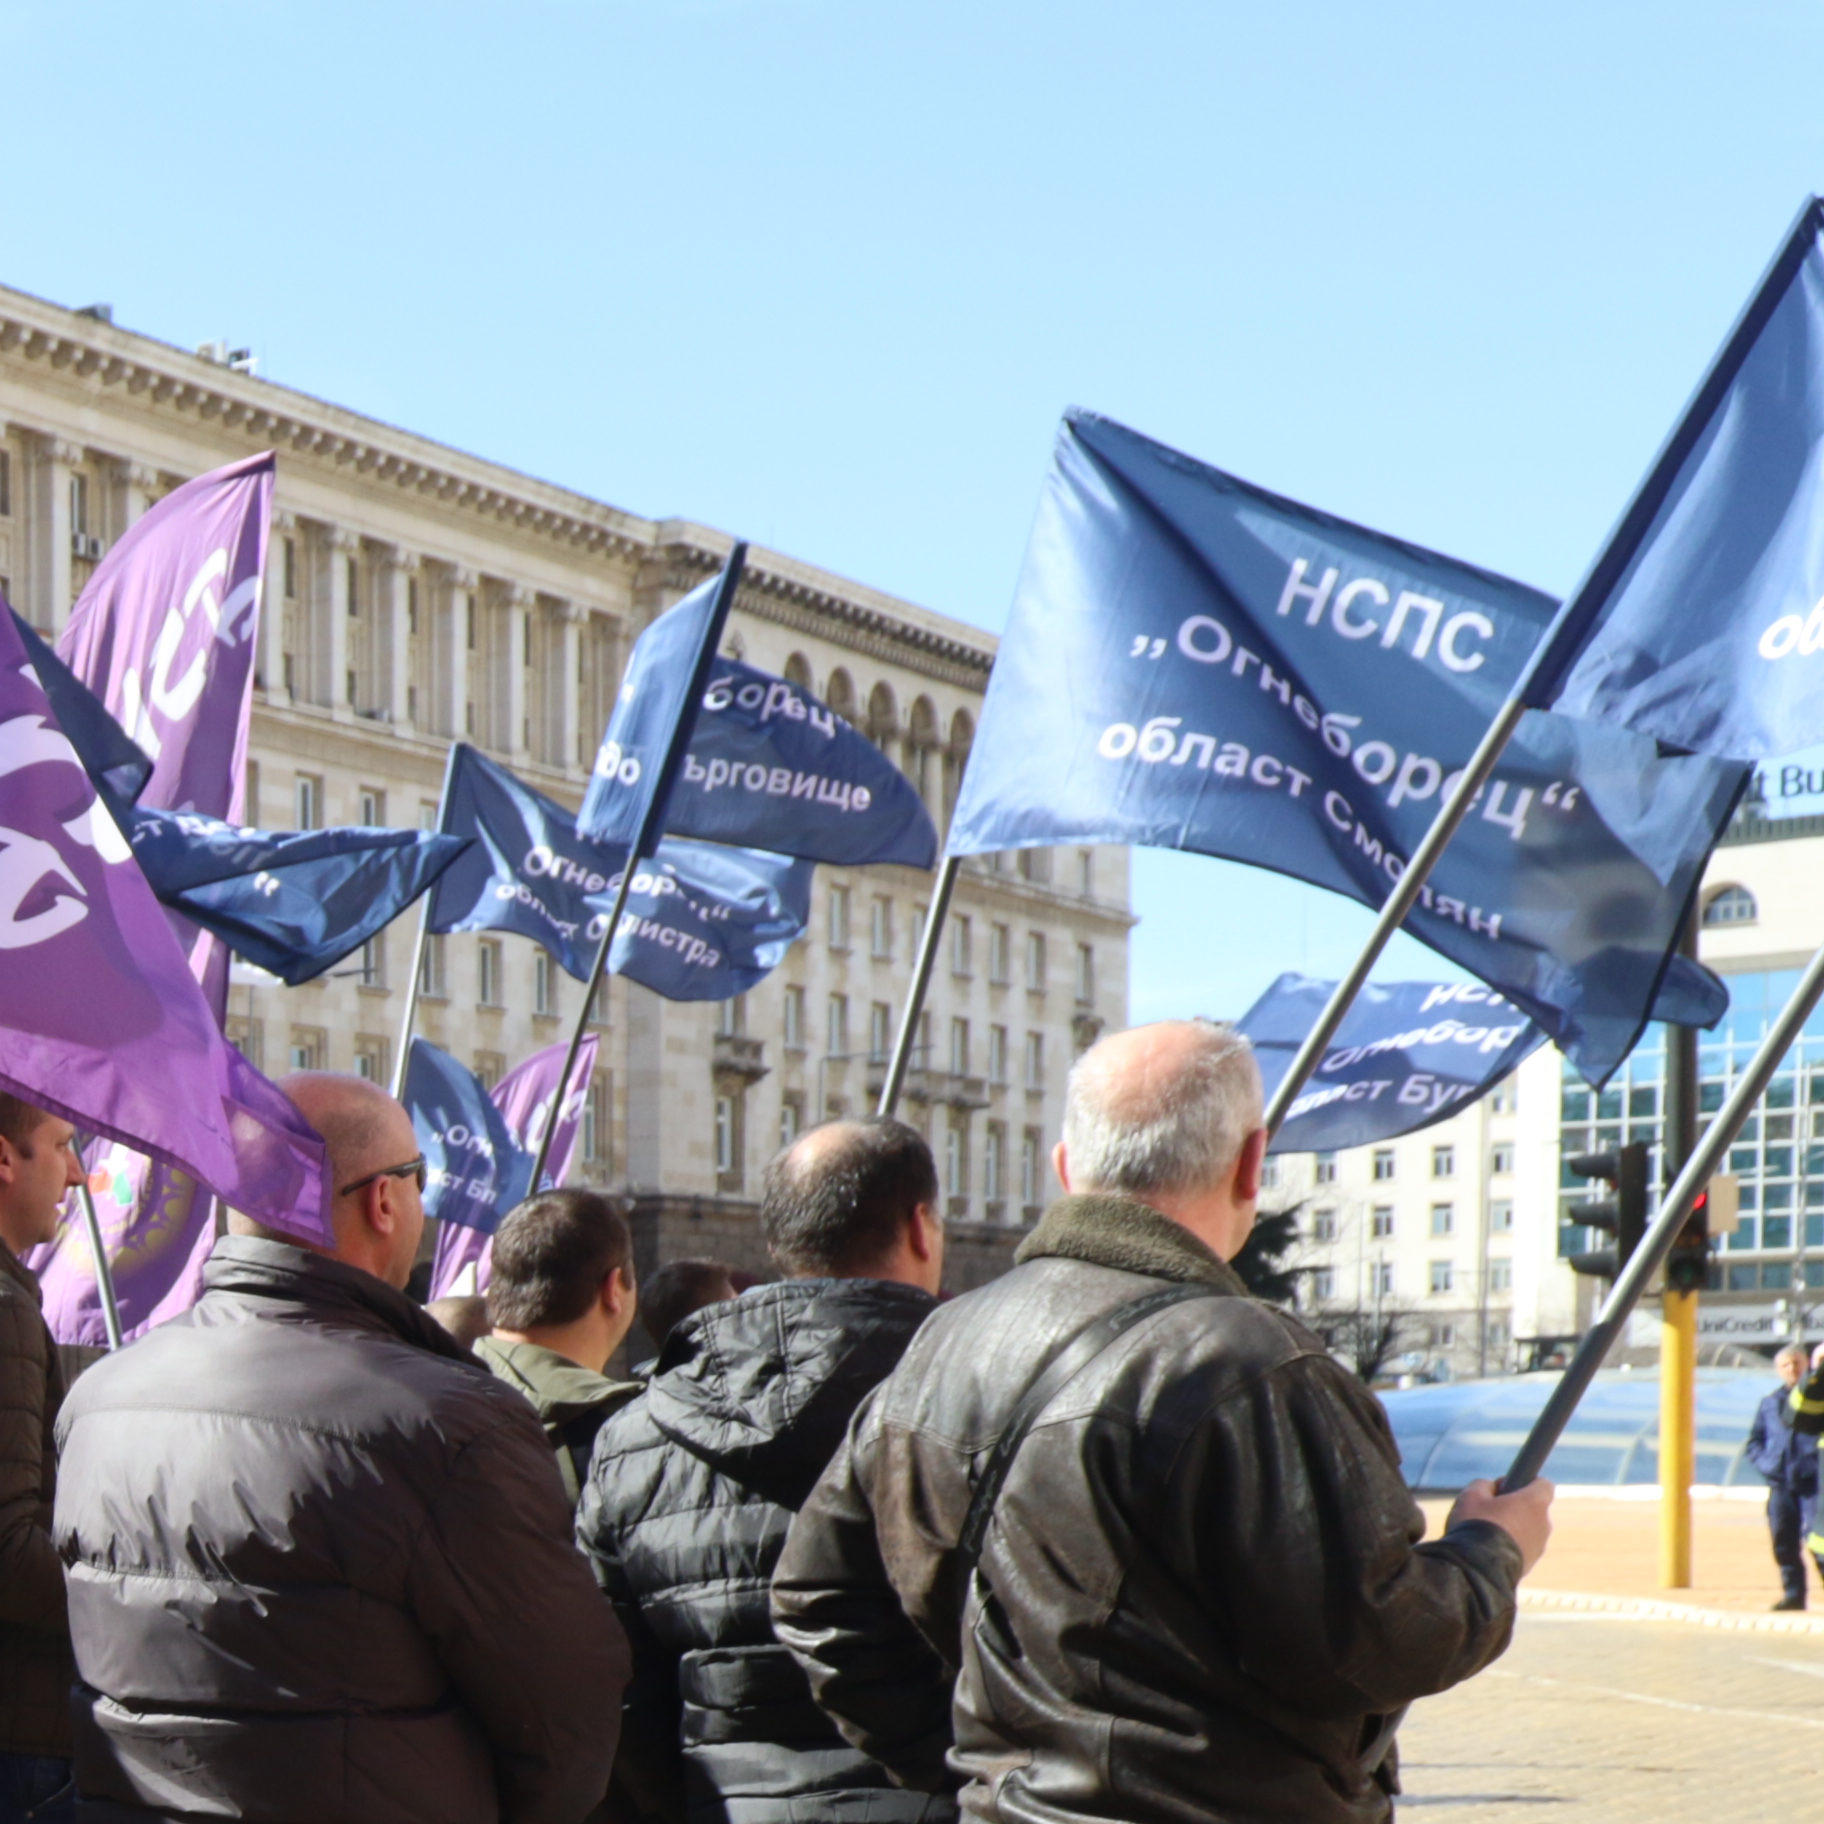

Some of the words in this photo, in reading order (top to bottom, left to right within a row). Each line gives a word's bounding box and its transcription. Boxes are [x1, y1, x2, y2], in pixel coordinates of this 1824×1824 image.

[1276, 556, 1494, 674] НСПС
[684, 754, 872, 811] ърговище
[1097, 717, 1313, 798] област
